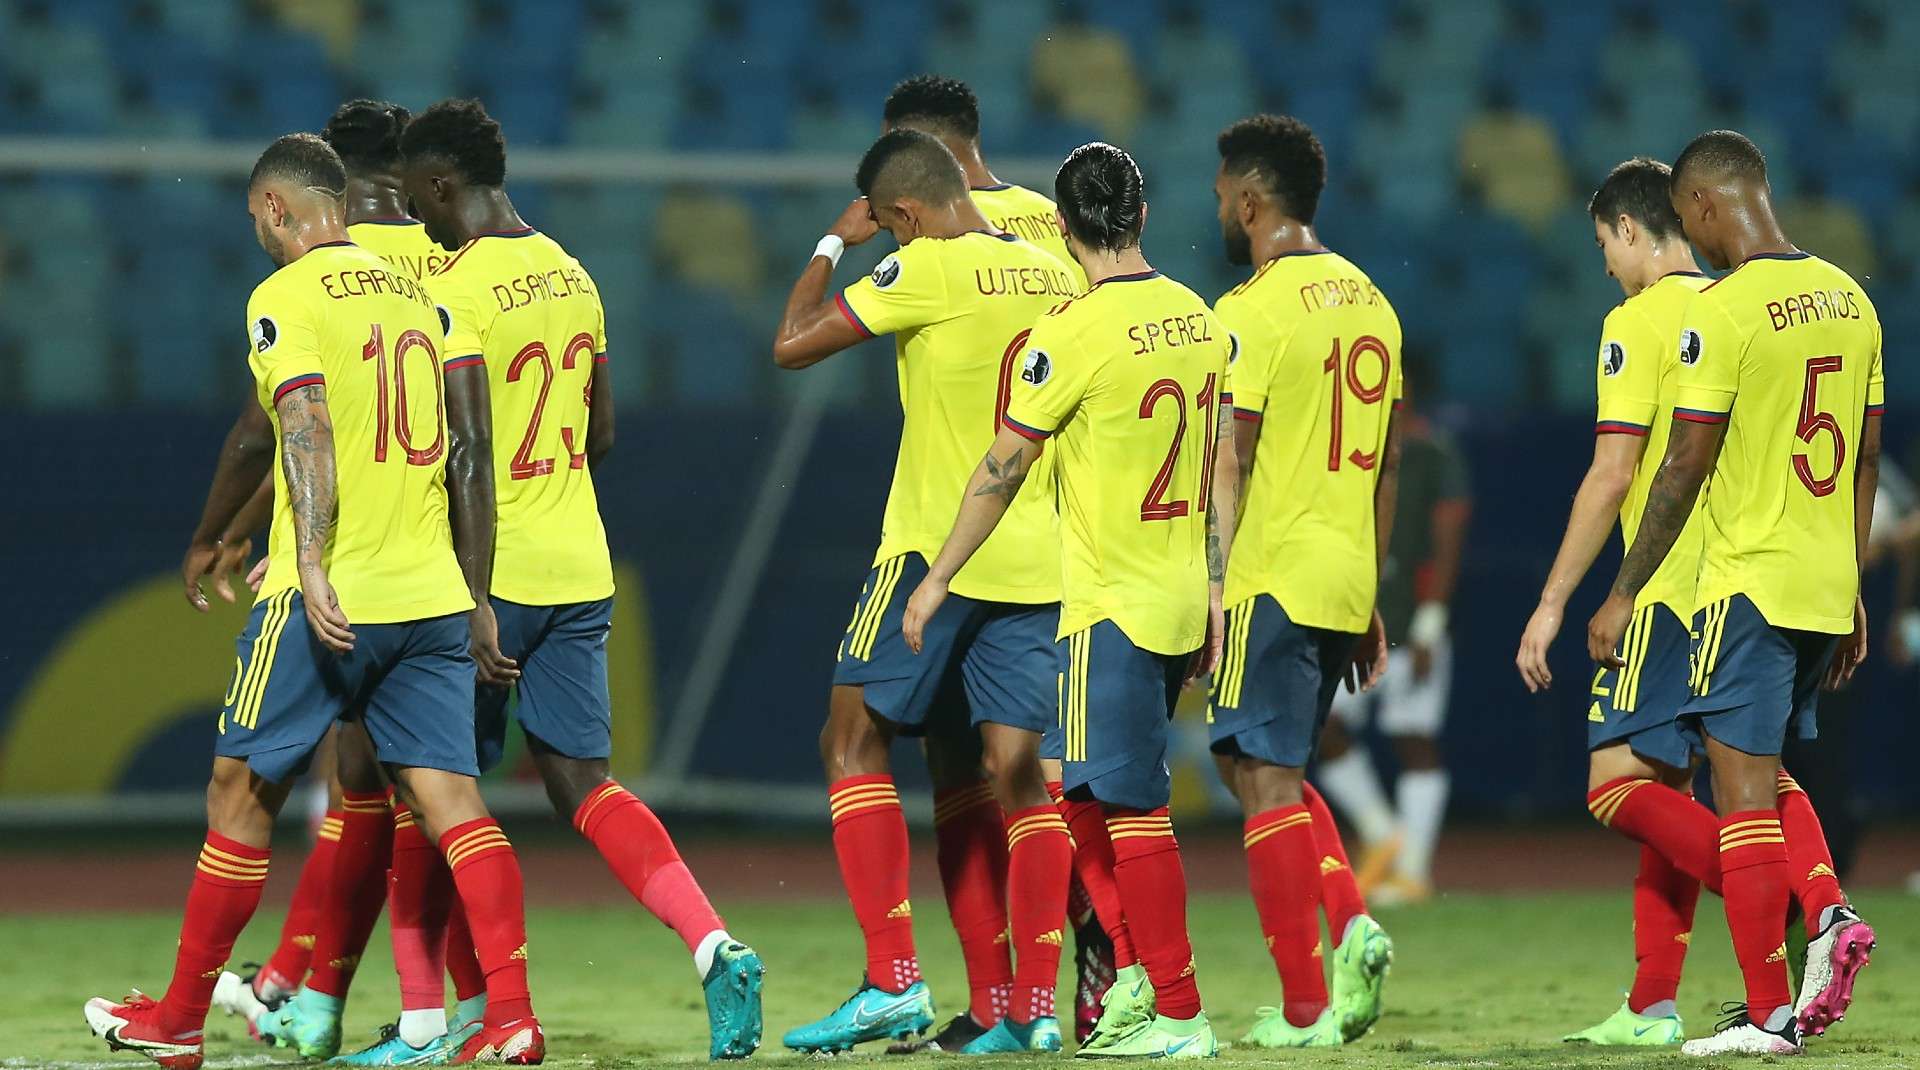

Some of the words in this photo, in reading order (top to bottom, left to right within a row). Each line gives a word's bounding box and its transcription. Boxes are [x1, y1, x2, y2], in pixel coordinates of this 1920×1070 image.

[975, 268, 1074, 298] W.TESILLO
[1127, 313, 1212, 356] S.PEREZ
[1765, 290, 1860, 332] BARRIOS
[363, 323, 445, 467] 10
[506, 332, 595, 481] 23
[1139, 372, 1217, 522] 21
[1323, 335, 1390, 472] 19
[1791, 355, 1846, 498] 5
